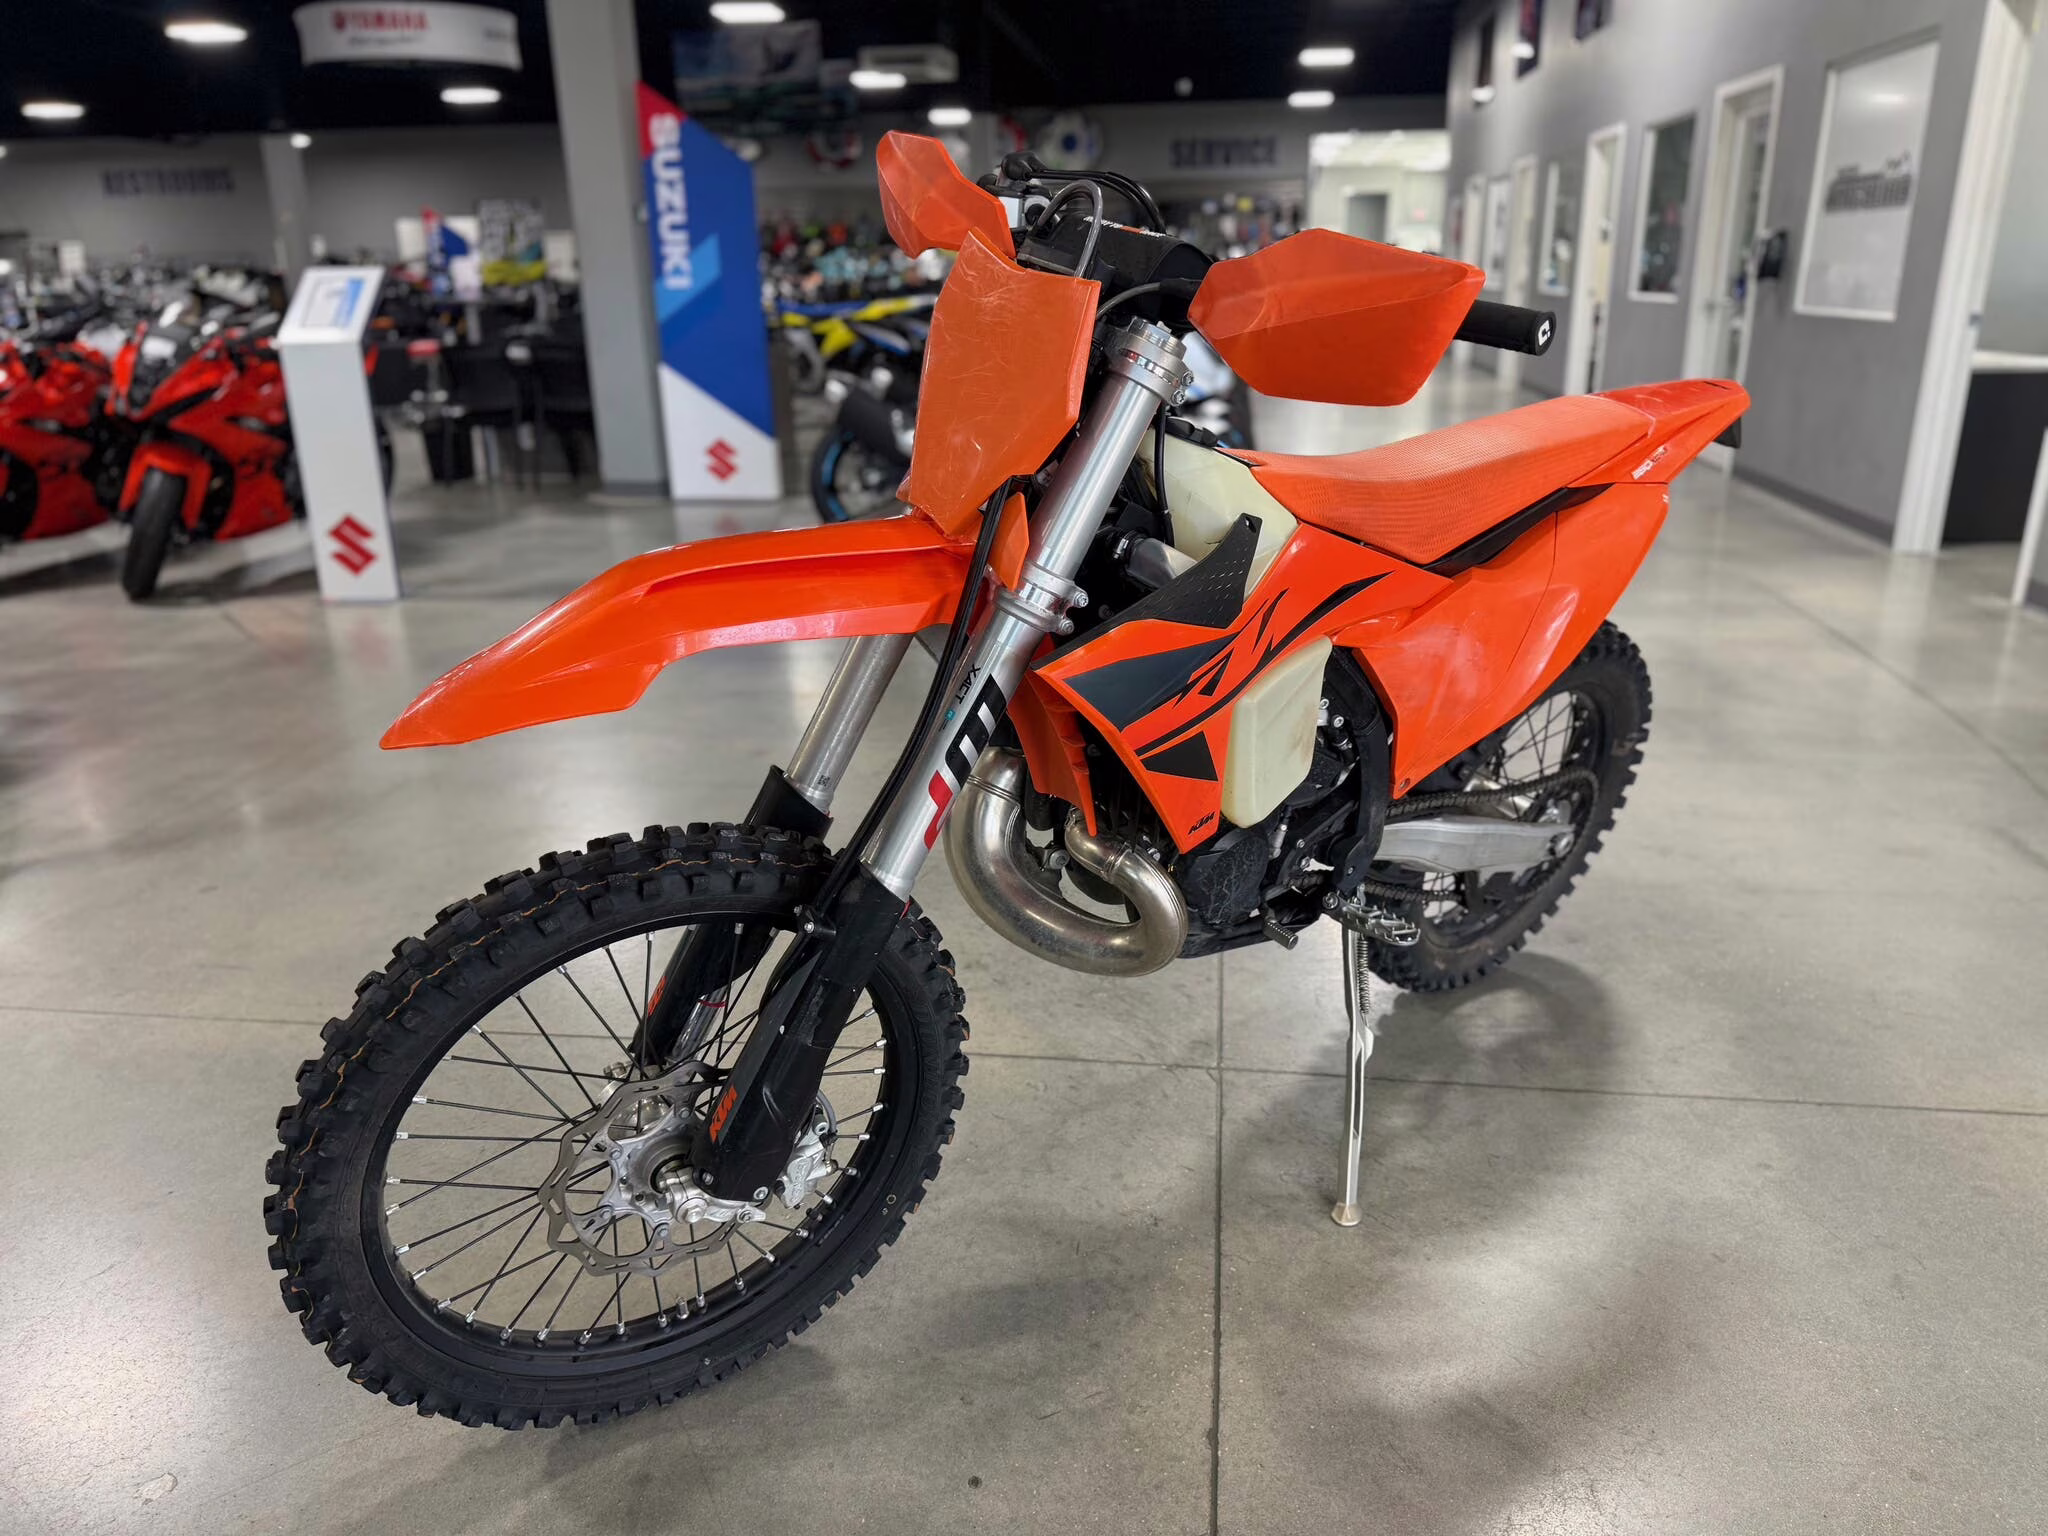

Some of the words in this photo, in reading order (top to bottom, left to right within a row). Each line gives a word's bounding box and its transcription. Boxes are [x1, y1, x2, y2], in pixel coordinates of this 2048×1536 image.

[1170, 138, 1277, 168] SERVICE
[649, 113, 692, 290] SUZUKI
[955, 664, 981, 704] XACT
[709, 1087, 738, 1144] KTM
